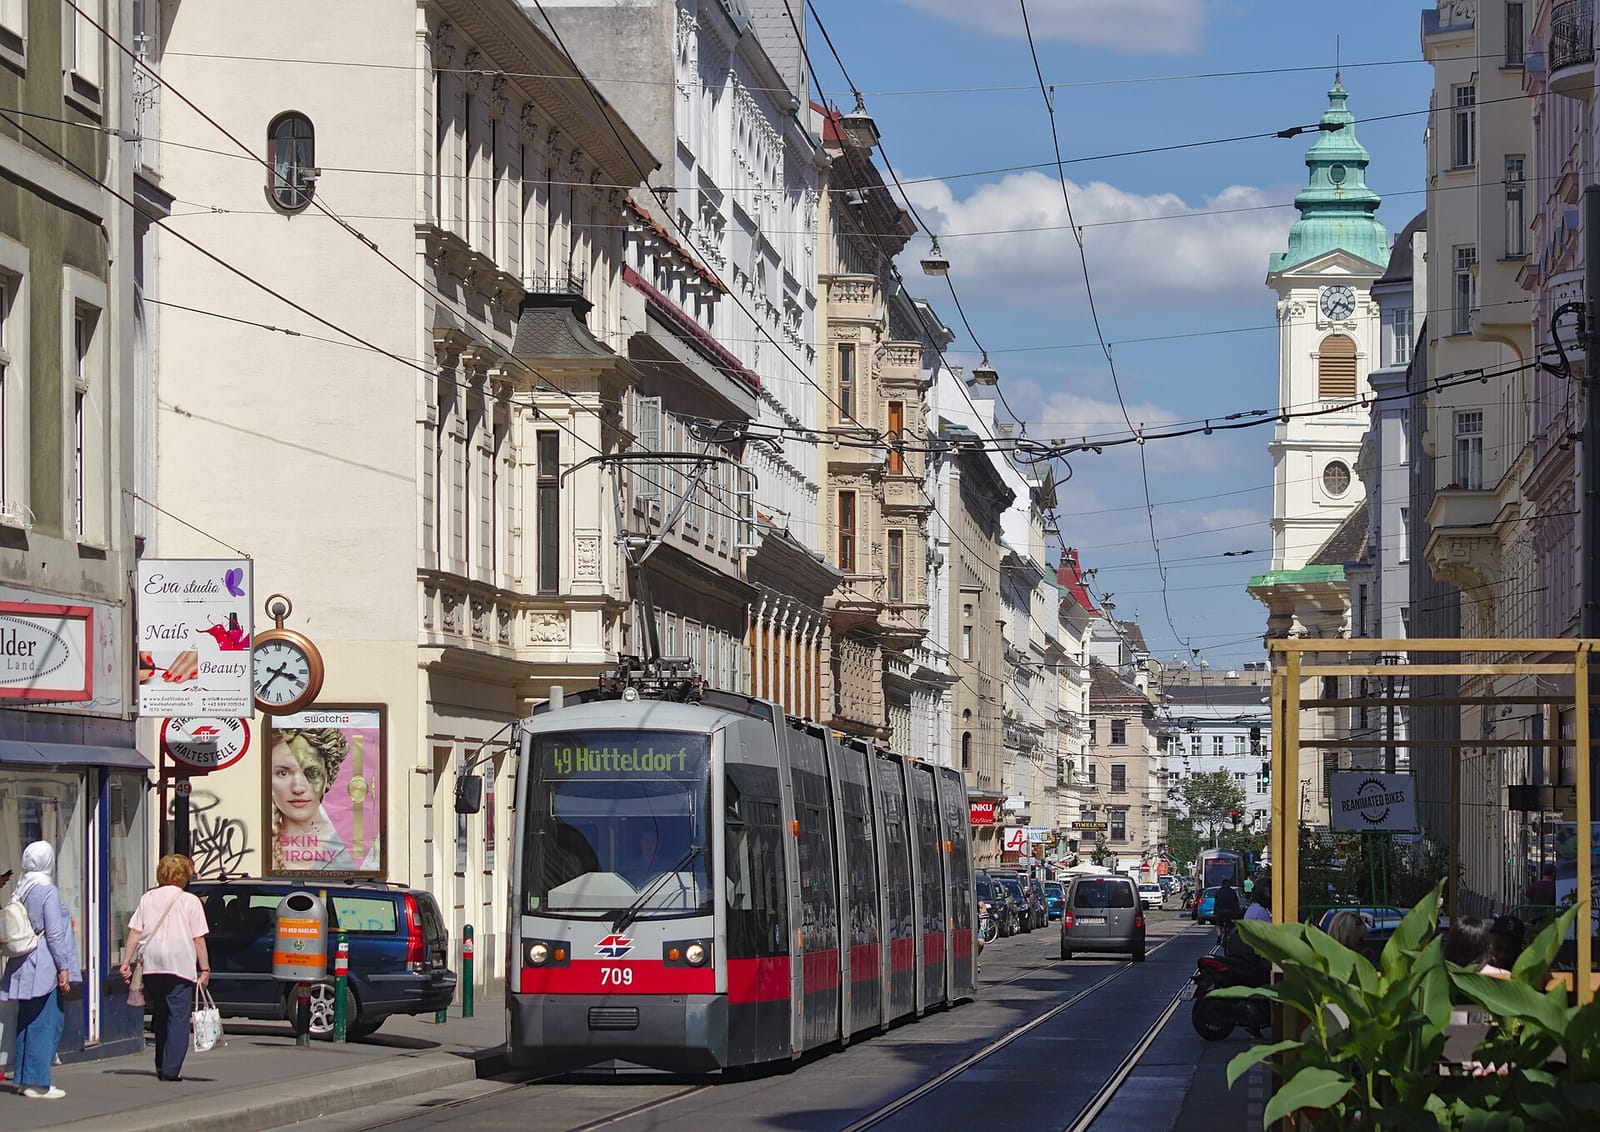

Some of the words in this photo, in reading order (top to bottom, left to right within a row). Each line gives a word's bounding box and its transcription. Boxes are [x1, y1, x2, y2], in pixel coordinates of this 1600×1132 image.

[144, 573, 181, 595] Eva
[183, 579, 221, 594] studio
[145, 622, 190, 640] Nails
[7, 658, 35, 670] Land
[199, 661, 247, 678] Beauty
[304, 715, 342, 723] swatch
[174, 742, 238, 763] HALTESTELLE
[553, 747, 572, 774] 49
[576, 747, 687, 772] Hütteldorf
[176, 783, 192, 794] 49
[971, 804, 993, 812] INKU
[1341, 794, 1385, 813] REANIMATED
[1384, 790, 1405, 806] BIKES
[279, 835, 318, 847] SKIN
[285, 850, 337, 862] IRONY
[601, 967, 633, 986] 709
